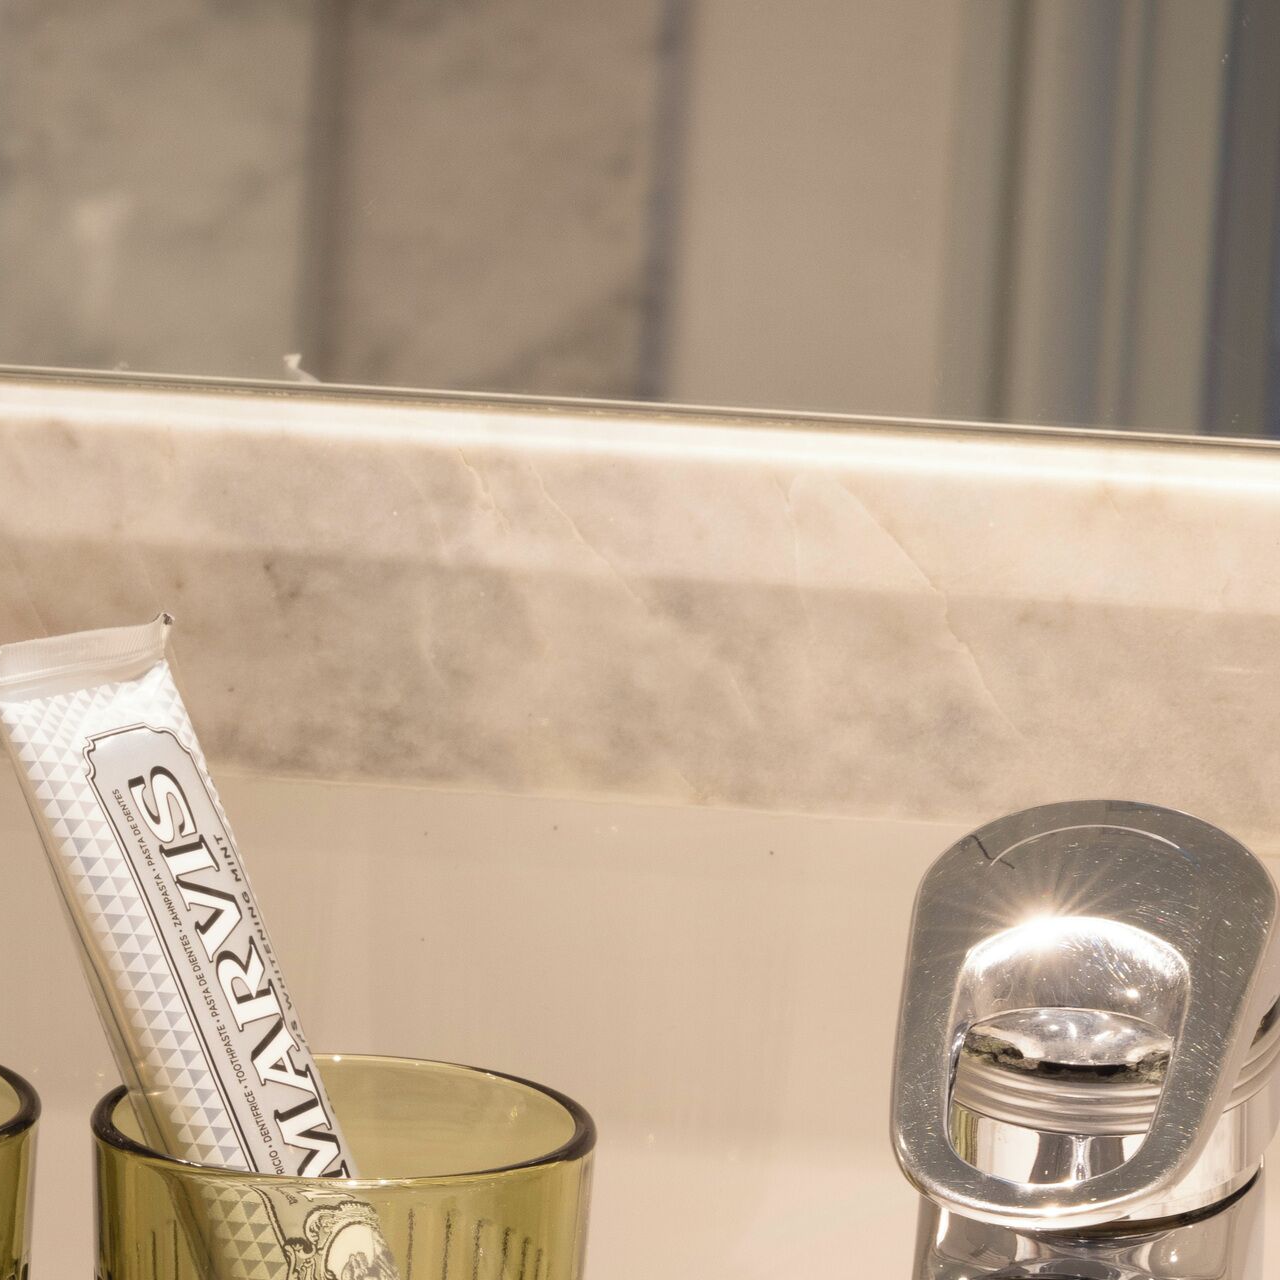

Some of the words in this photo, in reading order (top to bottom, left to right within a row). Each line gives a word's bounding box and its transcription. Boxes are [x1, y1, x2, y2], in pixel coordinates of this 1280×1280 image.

[111, 788, 134, 822] DENTES
[129, 822, 141, 836] DE
[136, 836, 155, 867] PASTA
[212, 834, 242, 883] MINT
[153, 872, 182, 928] ZAHNPASTA
[178, 933, 201, 973] DIENTES
[240, 890, 293, 1011] WHITENING
[127, 766, 352, 1199] MARVIS
[194, 972, 207, 987] DE
[201, 986, 220, 1018] PASTA
[215, 1023, 247, 1084] TOOTHPASTE
[243, 1089, 273, 1144] DENTIFRICE
